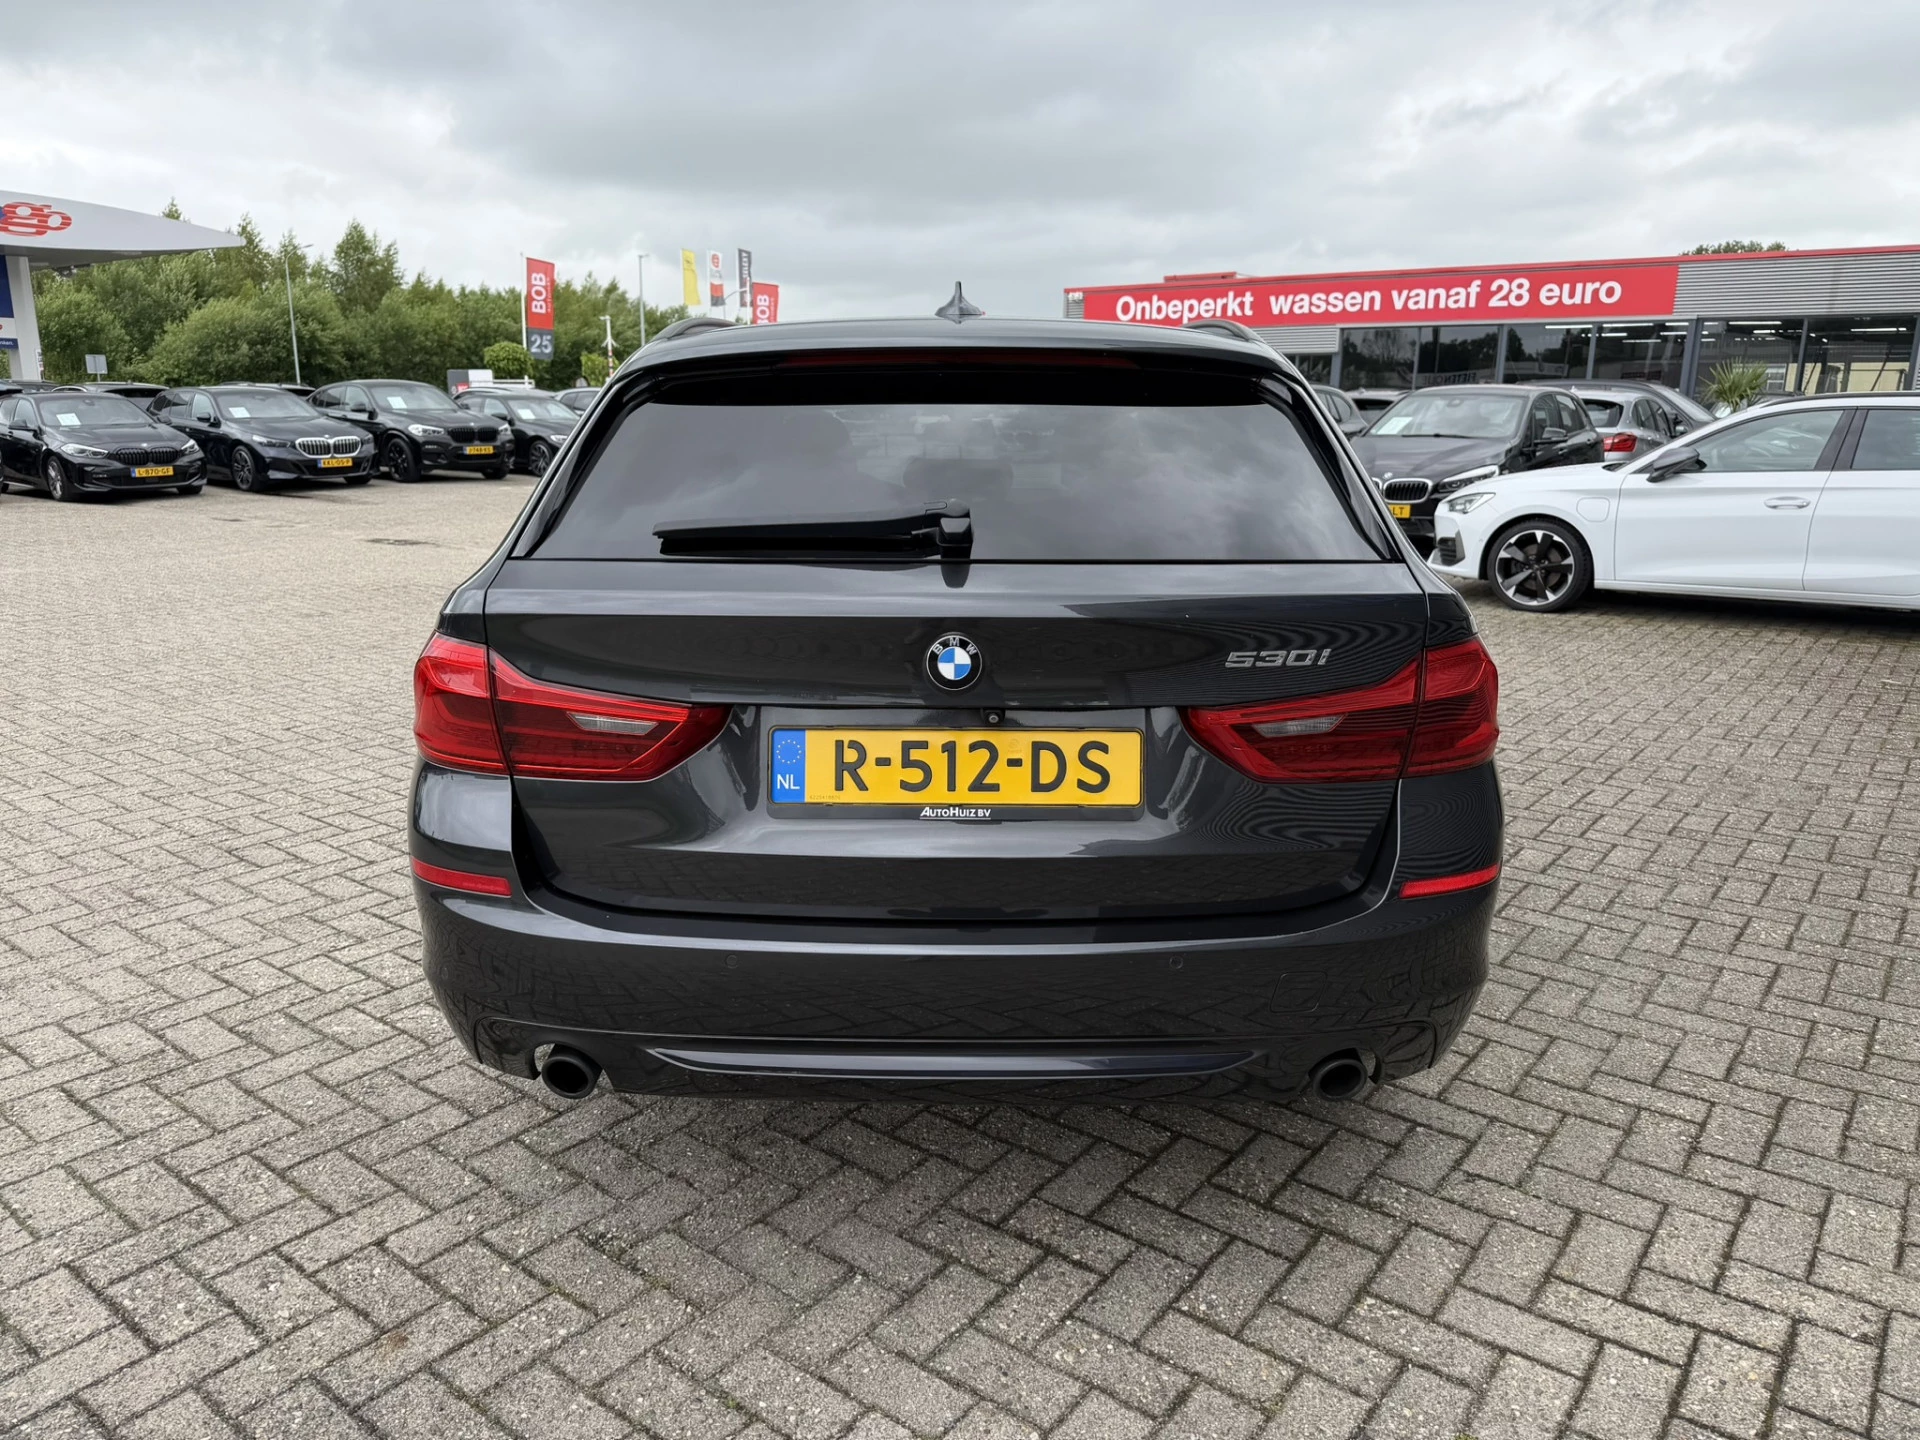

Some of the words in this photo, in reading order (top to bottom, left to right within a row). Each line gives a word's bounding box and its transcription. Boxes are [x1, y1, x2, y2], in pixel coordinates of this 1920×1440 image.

[531, 272, 547, 314] BOB
[1115, 290, 1254, 323] Onbeperkt
[1269, 289, 1382, 315] wassen
[1391, 279, 1482, 311] vanaf
[1488, 277, 1531, 308] 28
[1539, 280, 1623, 306] euro
[530, 334, 553, 354] 25
[932, 636, 978, 656] BMW
[1224, 648, 1333, 668] 530i
[834, 739, 1111, 794] R-512-DS
[776, 774, 801, 790] NL
[977, 808, 992, 817] BV
